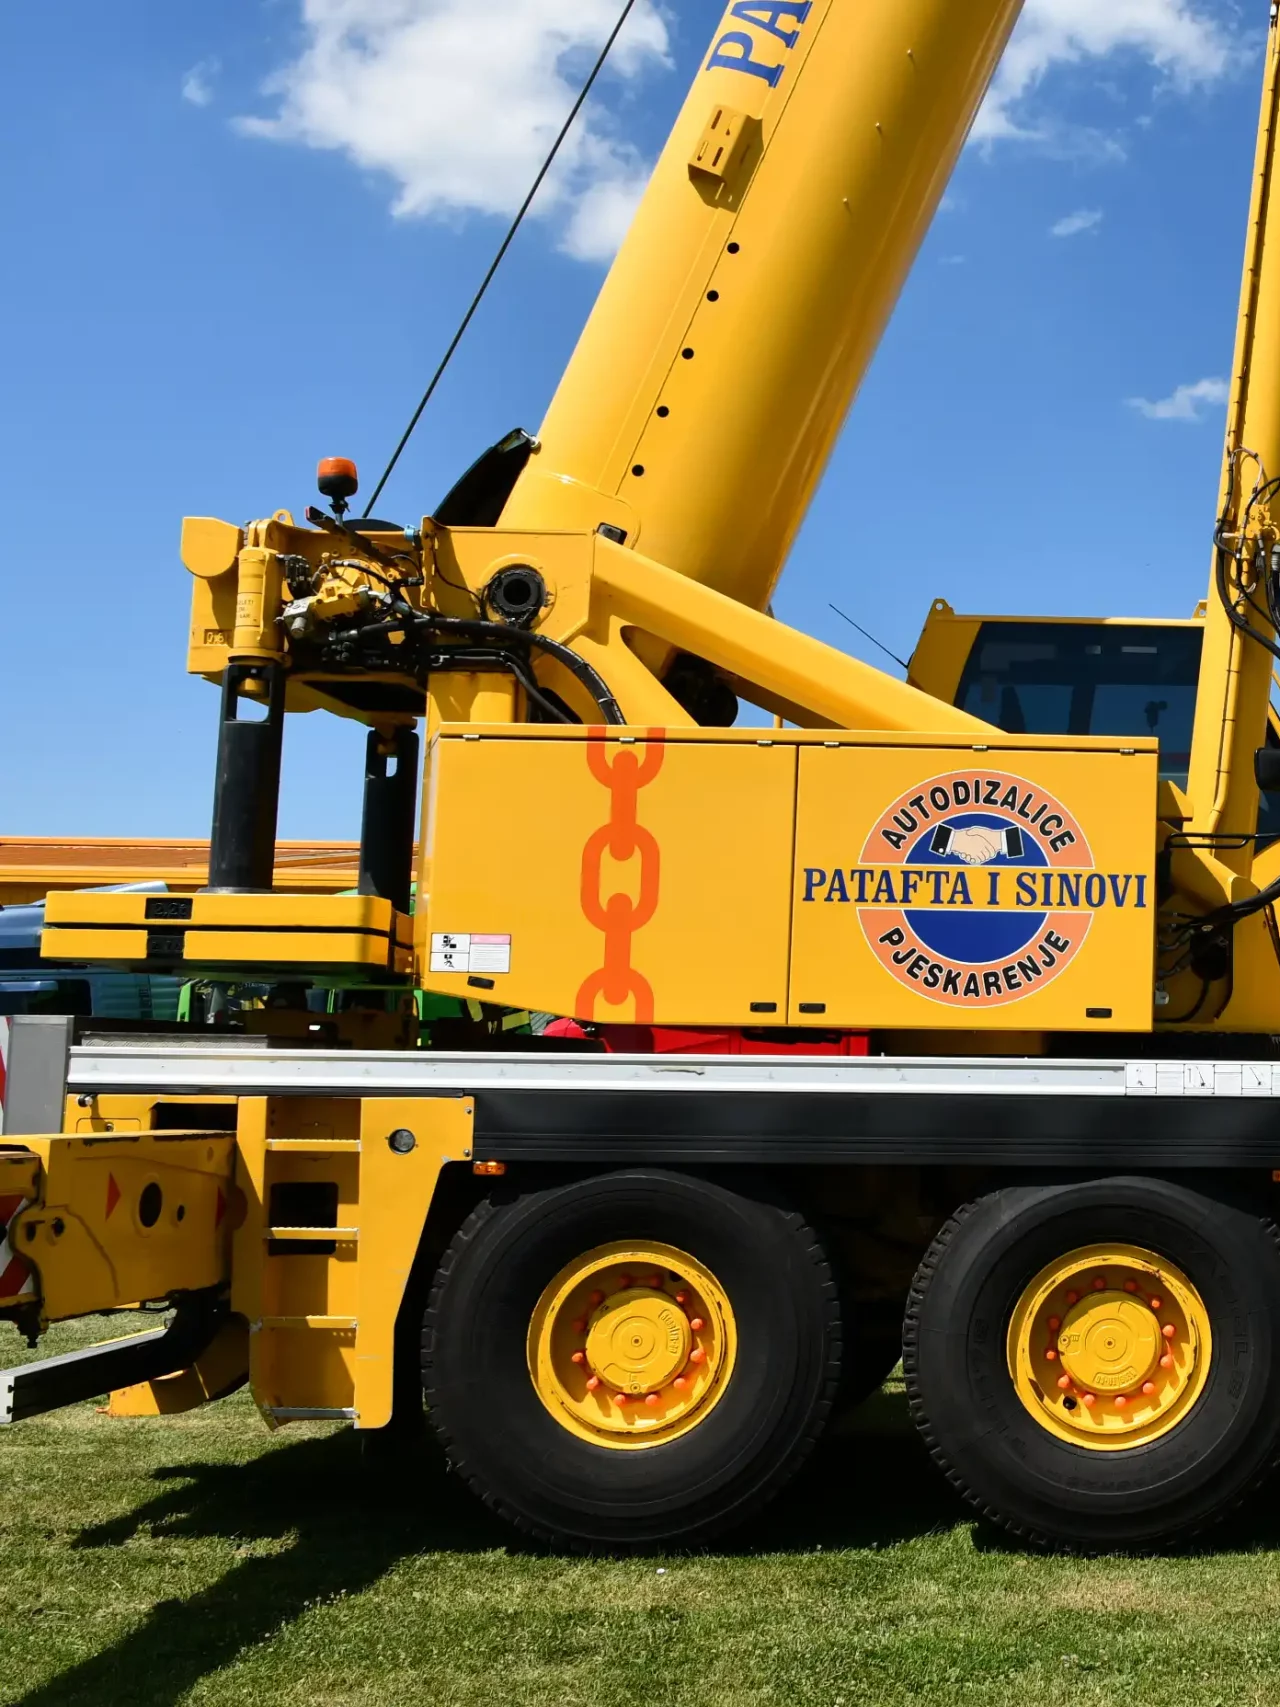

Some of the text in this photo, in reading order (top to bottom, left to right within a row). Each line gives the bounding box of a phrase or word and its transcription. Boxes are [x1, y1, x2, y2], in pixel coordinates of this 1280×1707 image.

[706, 0, 813, 88] PA
[880, 778, 1076, 853] AUTODIZALICE
[801, 867, 1148, 908] PATAFTA I SINOVI
[878, 926, 1071, 998] PJESKARENJE
